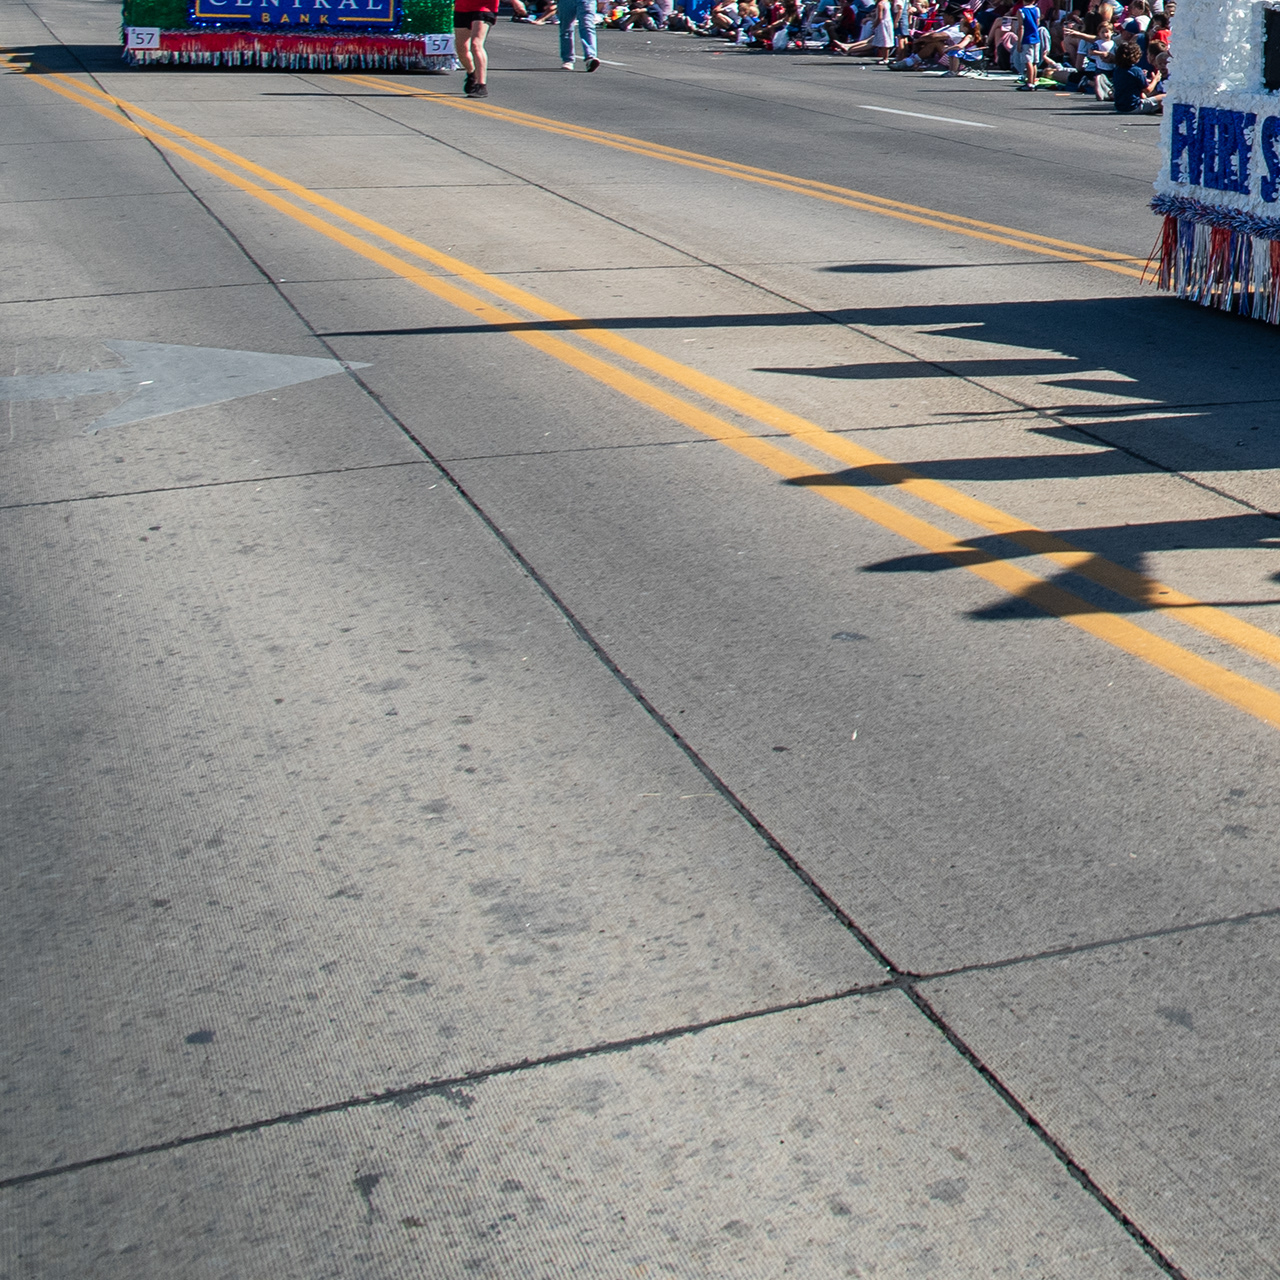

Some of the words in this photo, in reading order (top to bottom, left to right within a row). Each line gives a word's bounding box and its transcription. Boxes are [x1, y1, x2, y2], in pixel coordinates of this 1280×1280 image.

[261, 13, 330, 24] BANK
[135, 32, 156, 46] 57
[431, 38, 450, 52] 57
[1170, 103, 1257, 196] EVERY
